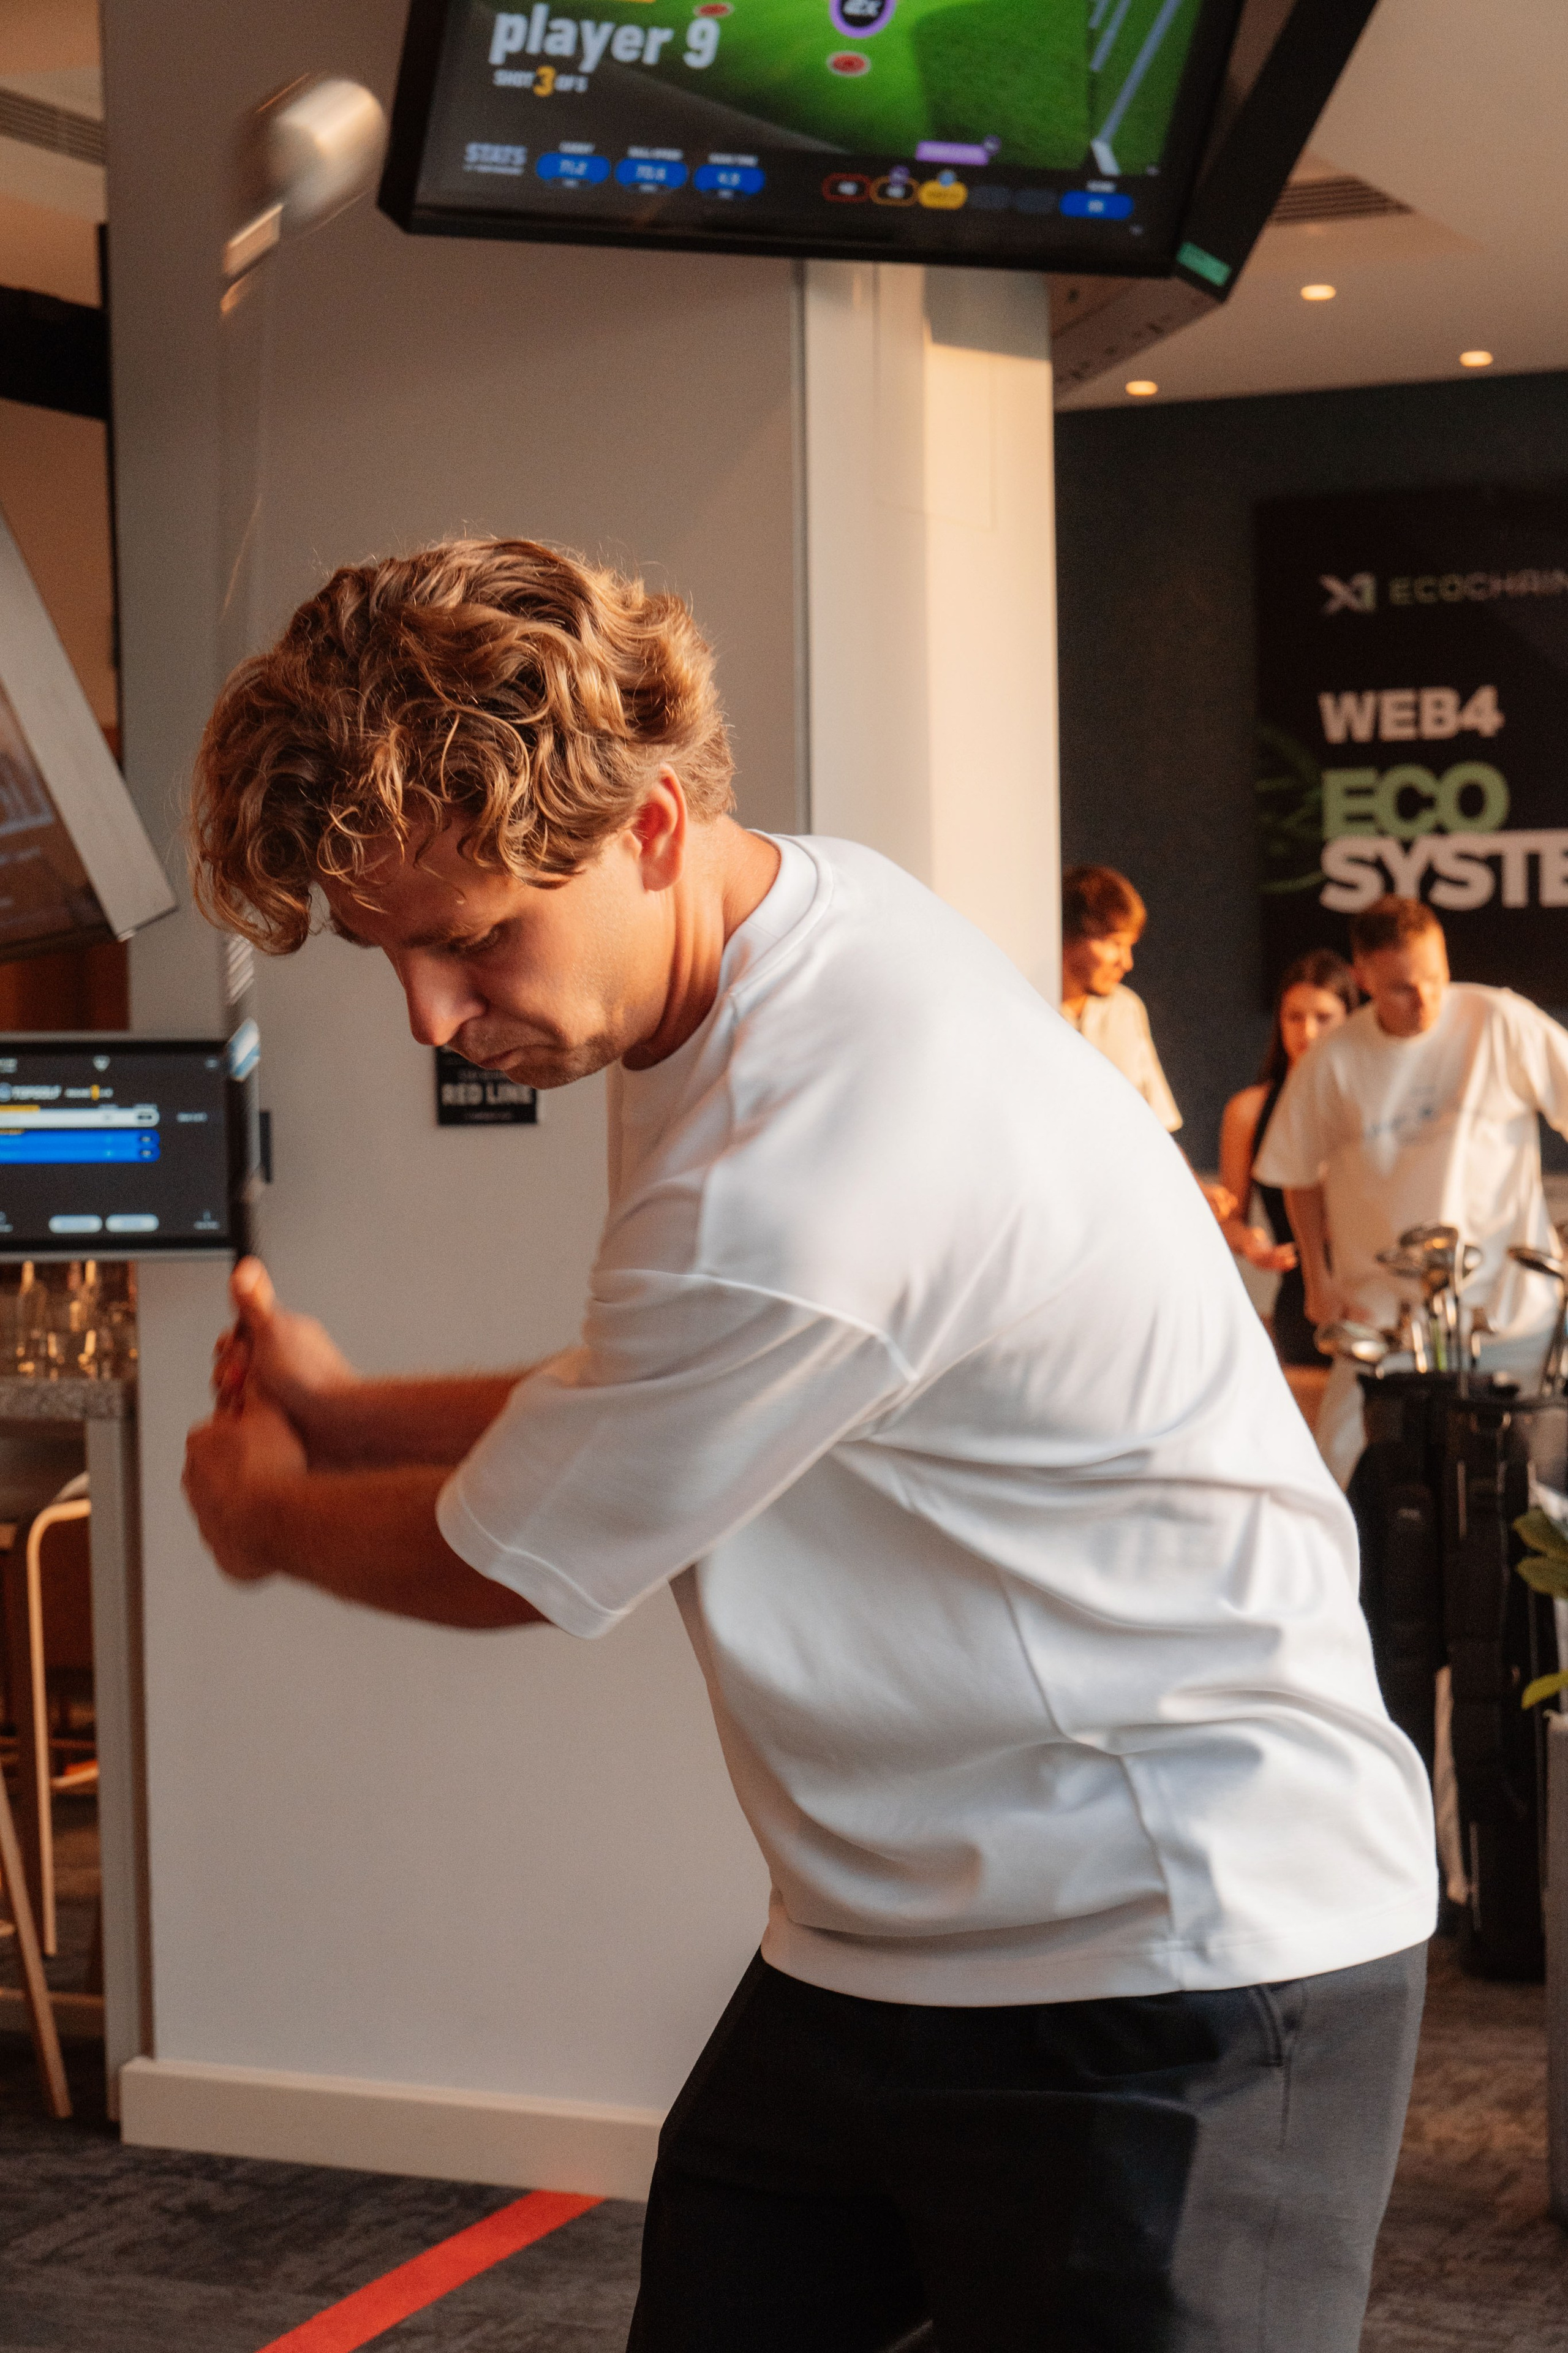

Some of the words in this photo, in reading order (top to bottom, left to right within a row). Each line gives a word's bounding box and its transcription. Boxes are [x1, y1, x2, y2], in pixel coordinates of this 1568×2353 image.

[488, 2, 674, 73] player
[682, 17, 721, 69] 9
[533, 65, 556, 97] 3
[1318, 684, 1505, 744] WEB4
[1321, 760, 1510, 841] ECO
[1319, 828, 1568, 913] SYSTE
